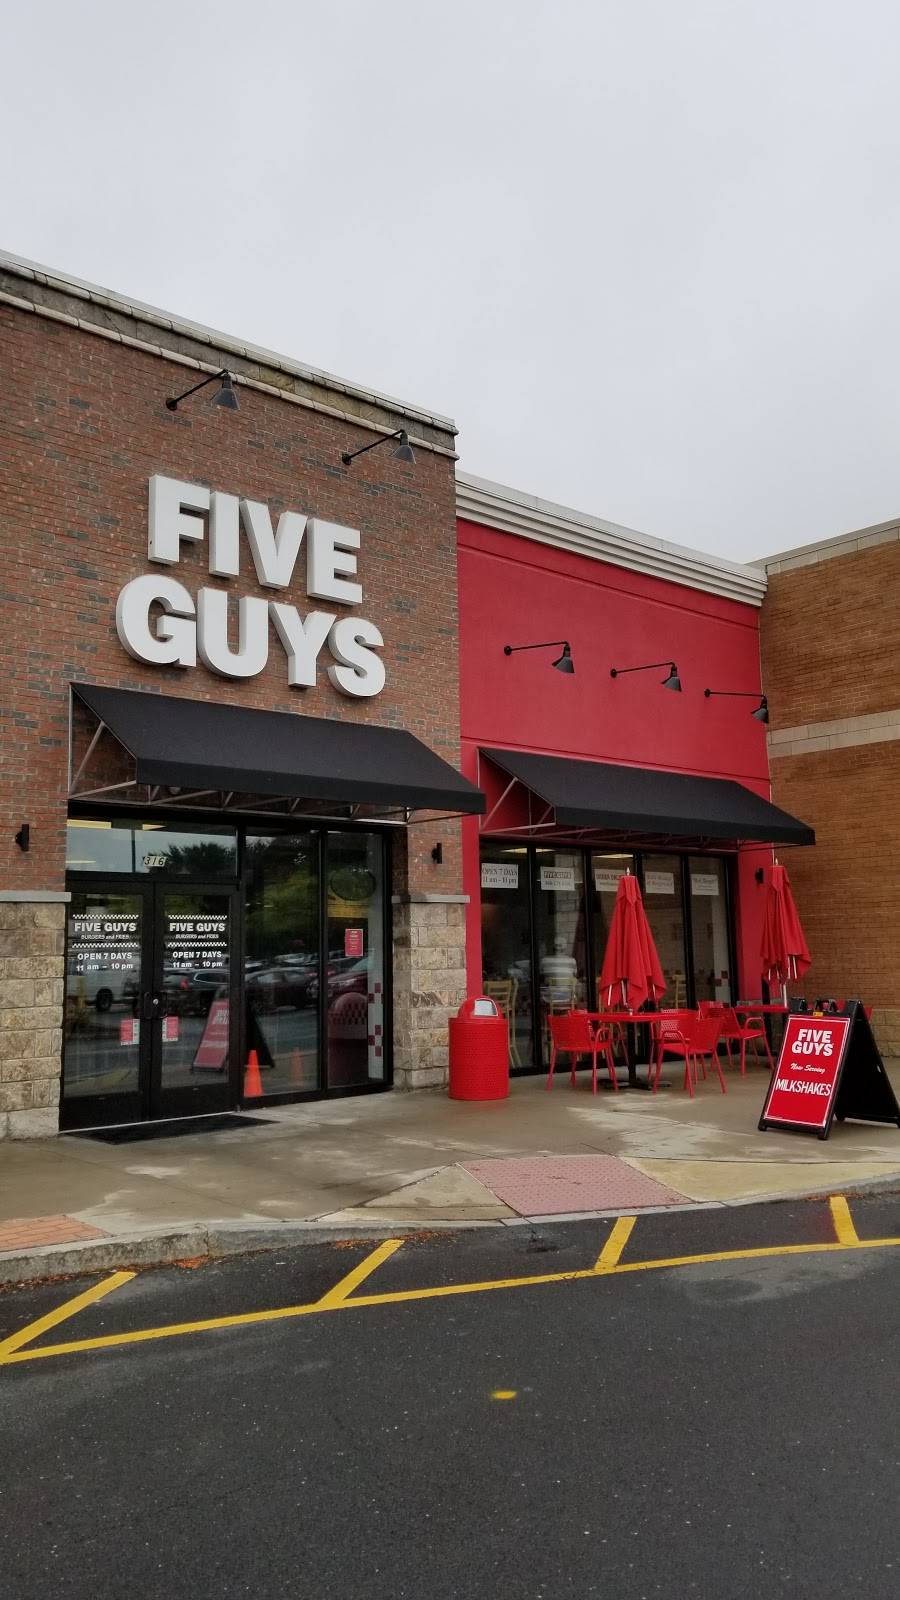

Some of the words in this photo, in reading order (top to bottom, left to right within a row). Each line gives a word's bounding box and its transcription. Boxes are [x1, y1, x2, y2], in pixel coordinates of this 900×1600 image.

[148, 474, 363, 606] FIVE
[115, 574, 386, 698] GUYS
[144, 856, 164, 865] 316
[74, 922, 101, 932] FIVE
[104, 922, 136, 932] GUYS
[170, 923, 193, 931] FIVE
[197, 923, 225, 931] GUYS
[798, 1029, 832, 1043] FIVE
[792, 1042, 833, 1057] GUYS
[790, 1063, 803, 1071] Now
[804, 1064, 825, 1074] Serving
[776, 1079, 832, 1096] MILKSHAKES
